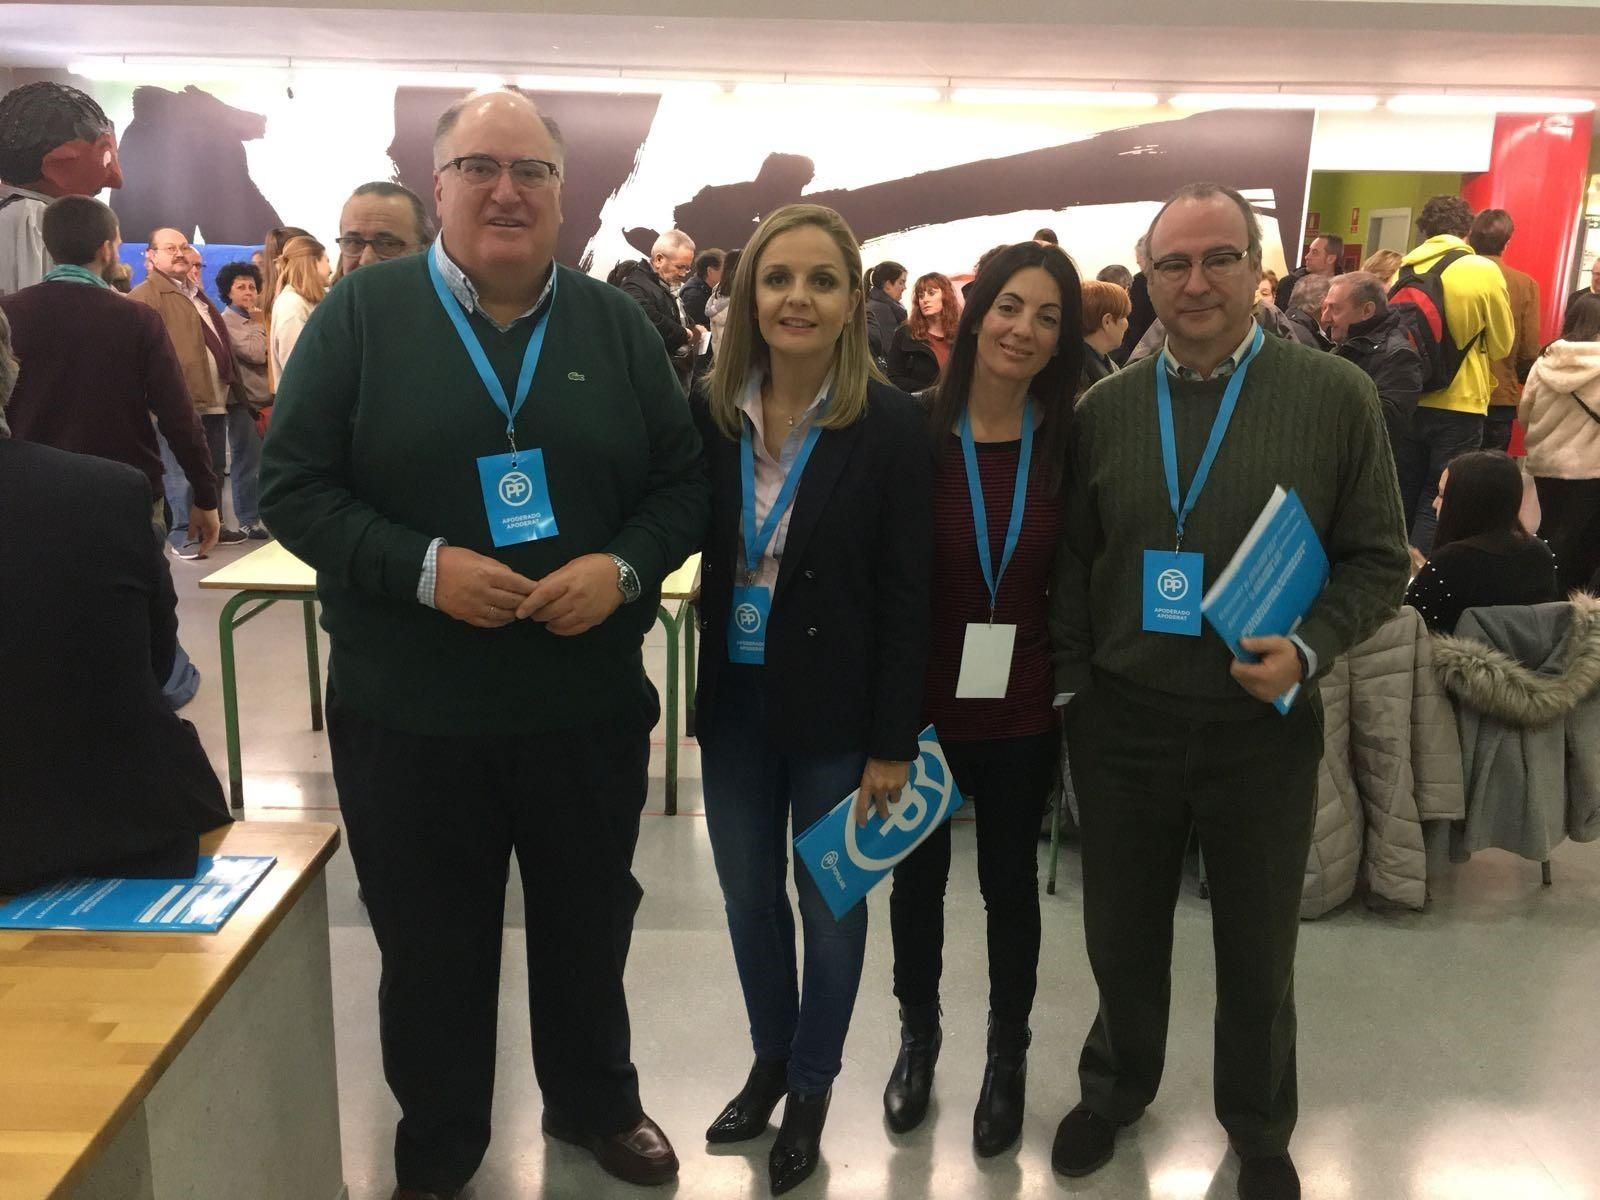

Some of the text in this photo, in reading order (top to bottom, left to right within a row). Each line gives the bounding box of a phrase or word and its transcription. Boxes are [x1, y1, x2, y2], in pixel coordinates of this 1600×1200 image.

[505, 482, 526, 498] PP
[502, 512, 541, 524] APODERADO
[1164, 579, 1182, 592] PP
[740, 612, 756, 625] PP
[1154, 608, 1190, 616] APODERADO
